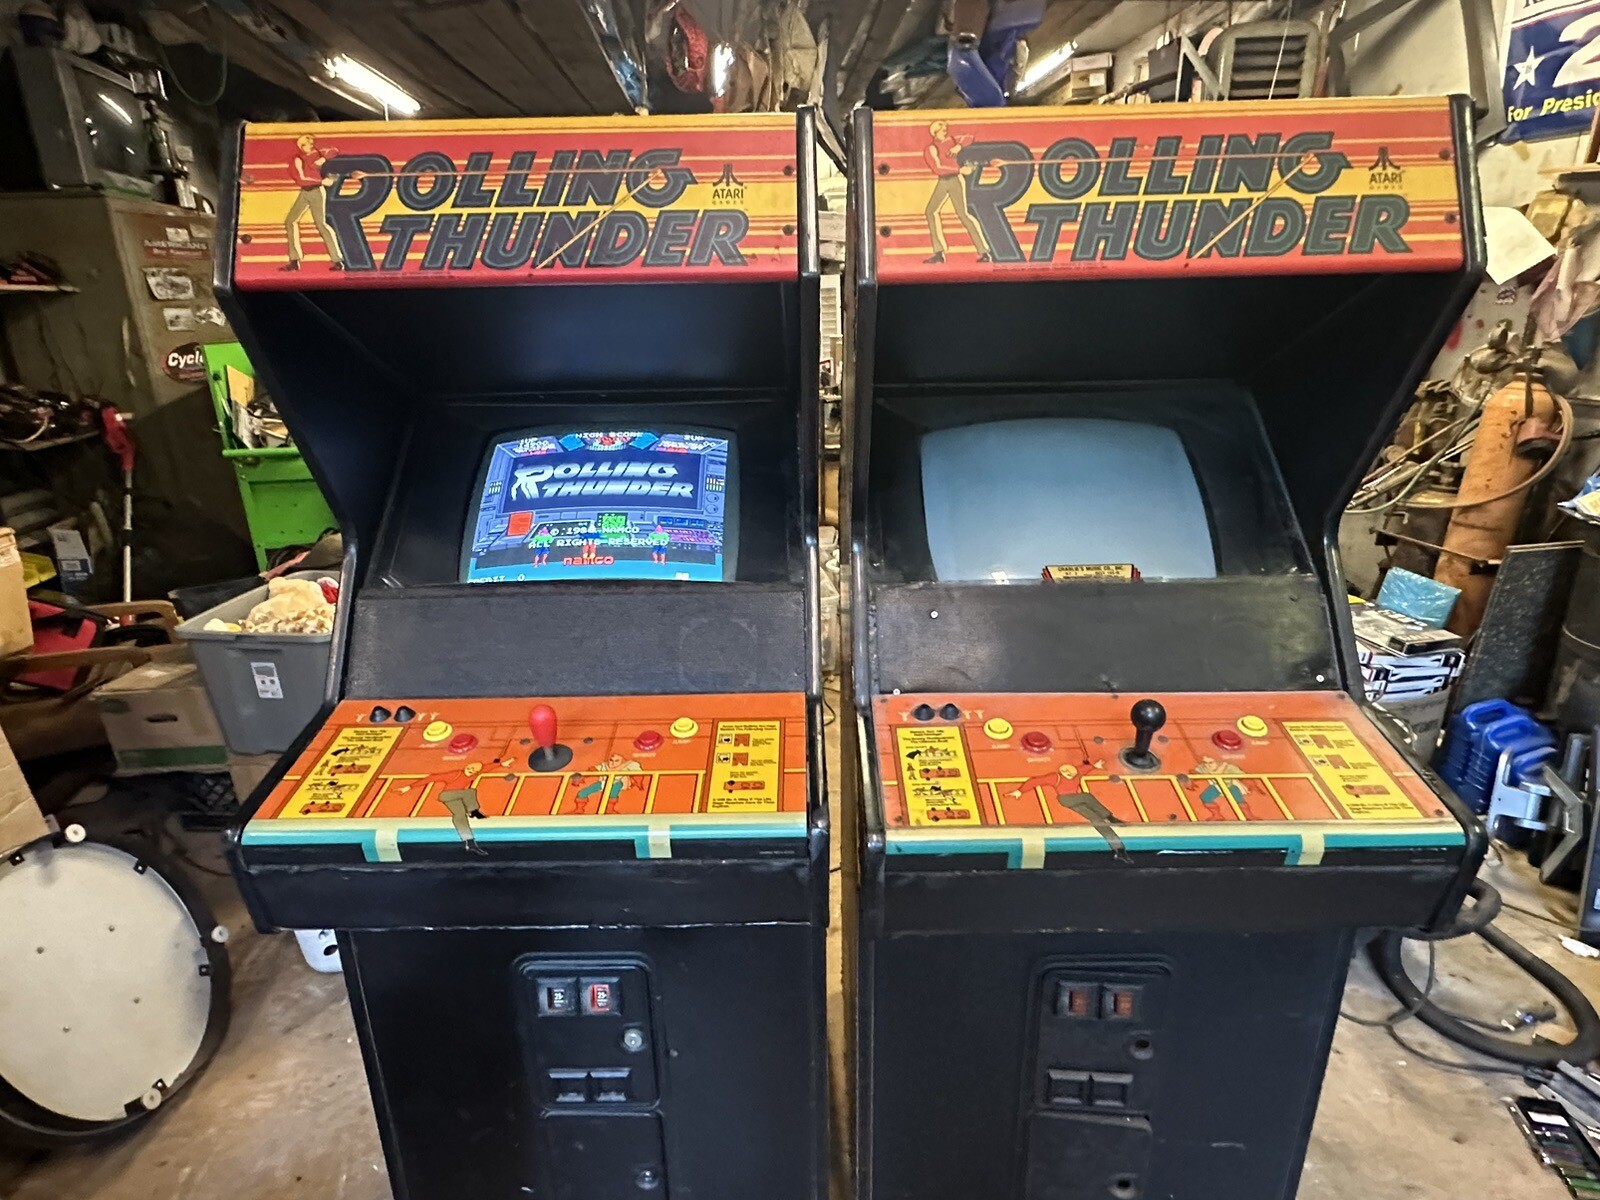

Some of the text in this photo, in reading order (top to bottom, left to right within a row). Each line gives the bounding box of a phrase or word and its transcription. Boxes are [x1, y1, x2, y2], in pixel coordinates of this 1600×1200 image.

[1507, 106, 1533, 122] for
[1369, 172, 1403, 184] ATARI
[712, 188, 744, 199] ATARI
[955, 131, 1352, 262] ROLLING
[321, 147, 698, 270] ROLLING
[1025, 193, 1414, 261] THUNDER
[379, 208, 750, 269] THUNDER
[511, 462, 678, 500] ROLLING
[542, 481, 694, 498] THUNDER
[602, 526, 640, 534] NAMCO
[556, 538, 601, 547] RIGHTS
[608, 537, 670, 546] RESERVED
[562, 555, 615, 566] namco
